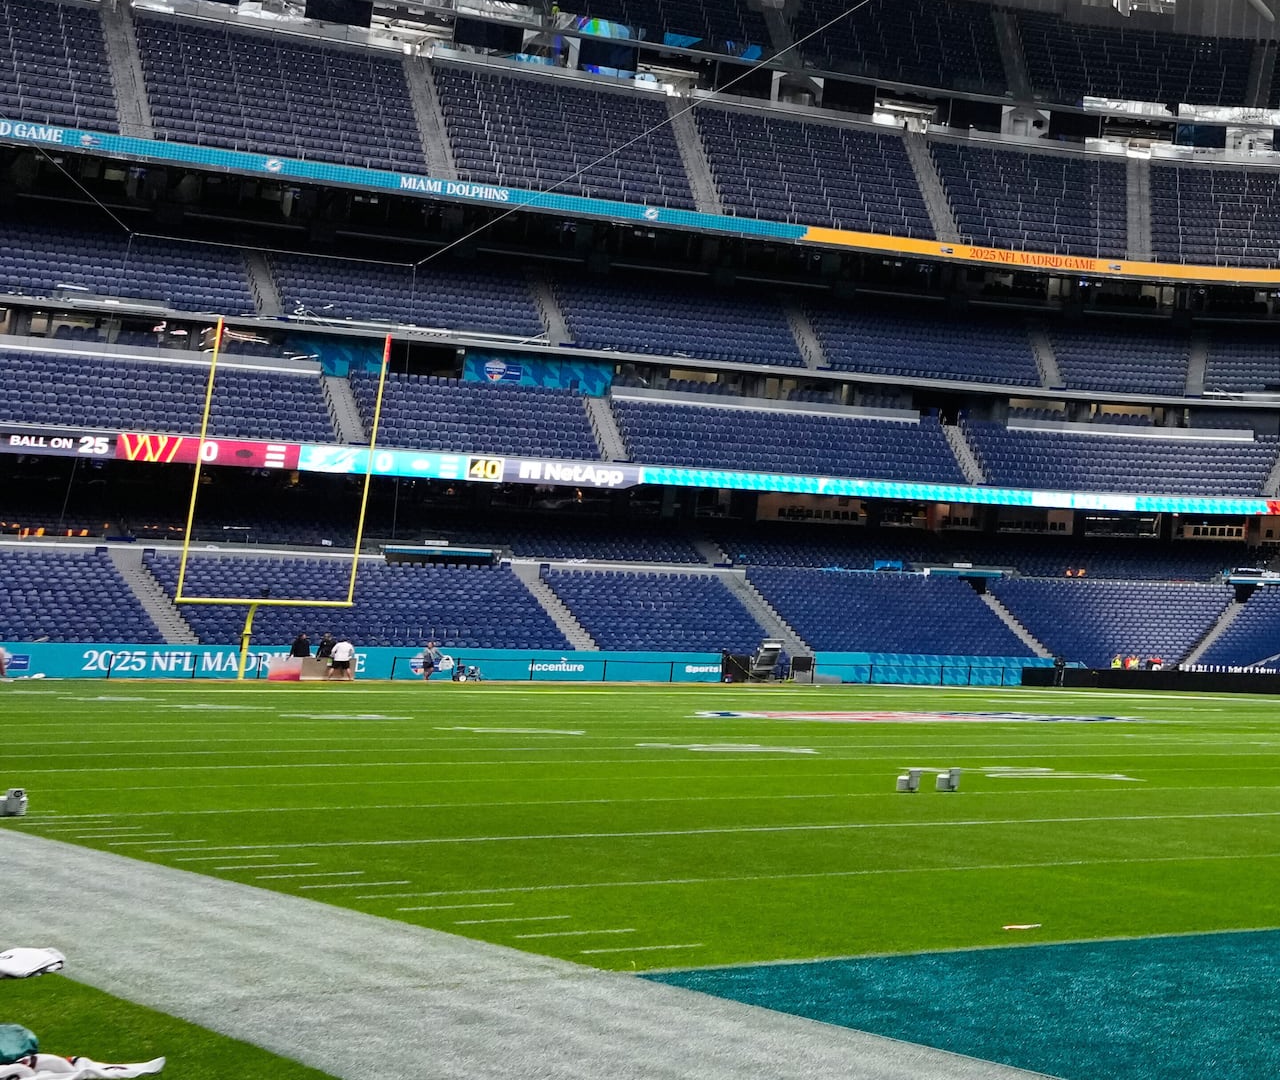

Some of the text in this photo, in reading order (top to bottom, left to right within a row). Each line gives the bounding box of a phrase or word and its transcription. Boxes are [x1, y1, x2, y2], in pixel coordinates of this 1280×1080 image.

[15, 123, 63, 143] GAME
[400, 176, 509, 201] MIAMI DOLPHINS
[969, 248, 1096, 270] 2025 NFL MADRID GAME
[9, 435, 109, 454] BALL ON 25
[200, 441, 219, 461] 0
[470, 459, 501, 479] 40
[543, 463, 624, 486] NetApp
[82, 650, 146, 671] 2025
[151, 651, 198, 672] NFL
[528, 660, 584, 672] accenture
